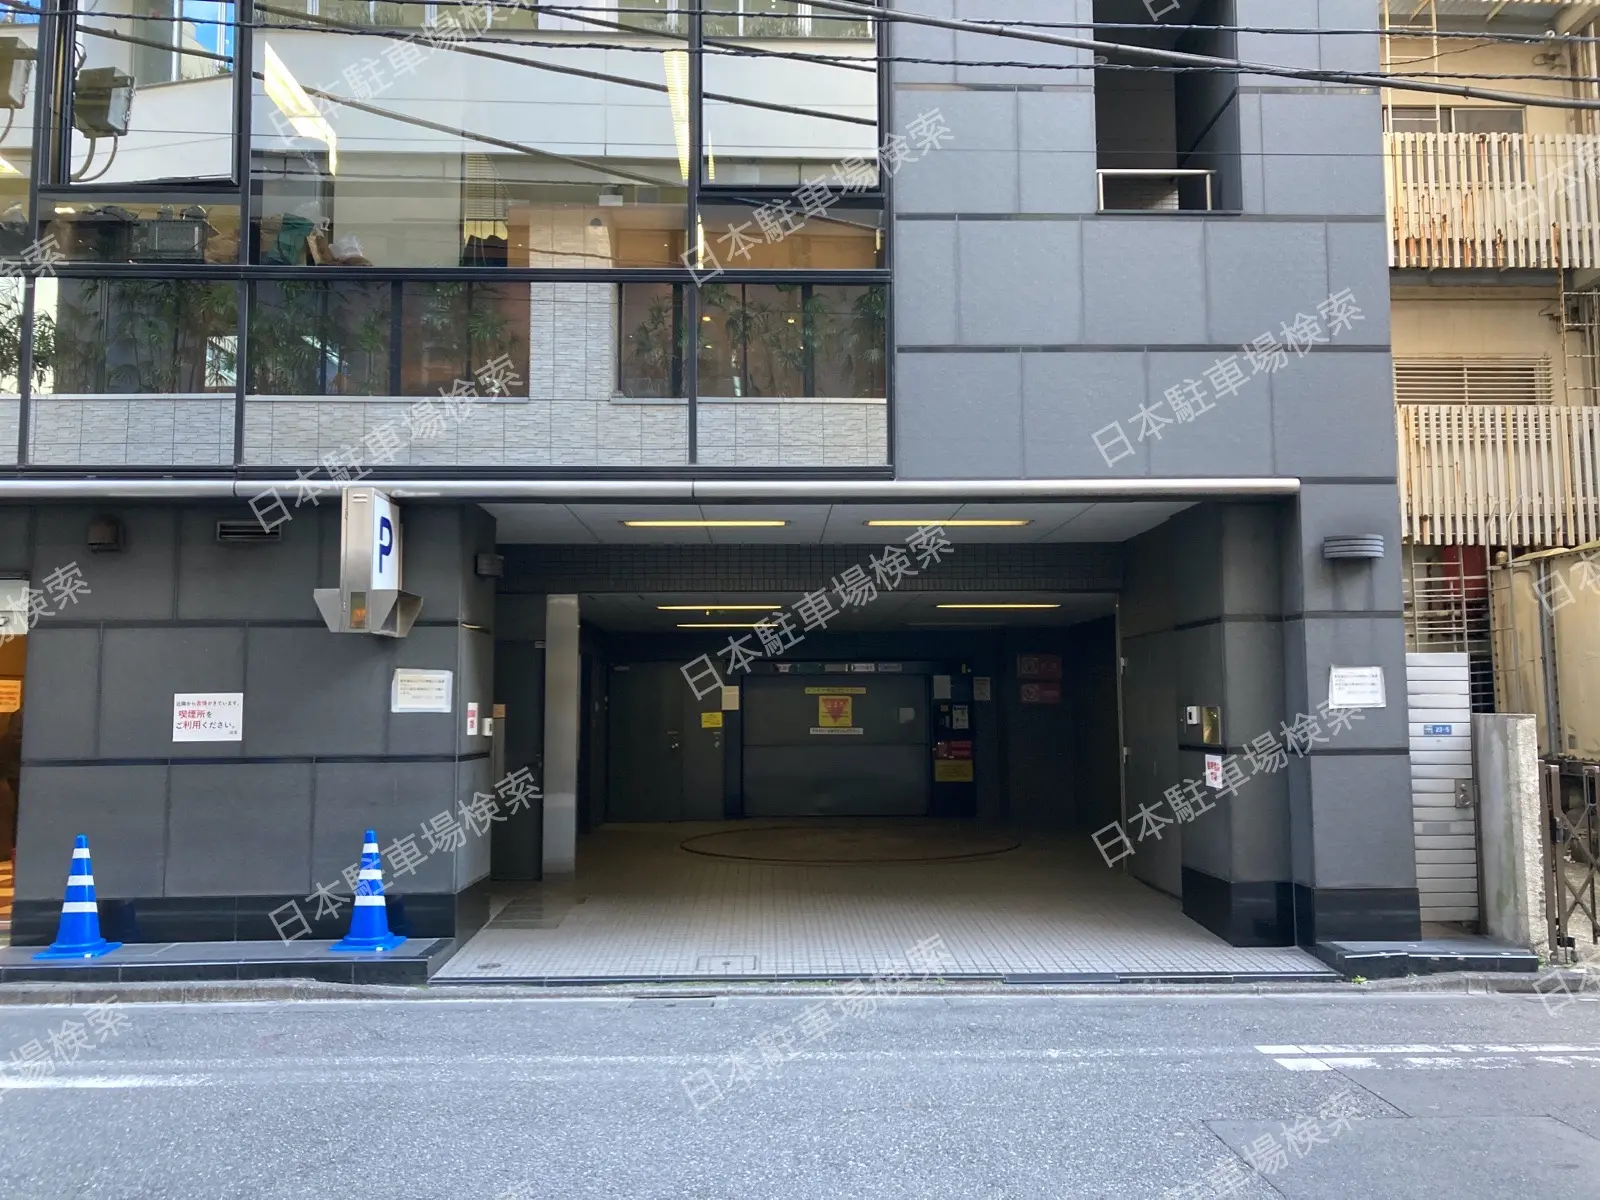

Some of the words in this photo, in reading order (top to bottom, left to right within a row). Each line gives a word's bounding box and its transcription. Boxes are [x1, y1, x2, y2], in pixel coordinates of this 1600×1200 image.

[378, 516, 393, 573] P
[178, 709, 213, 719] 喫煙所を
[176, 720, 235, 730] ご利用ください。
